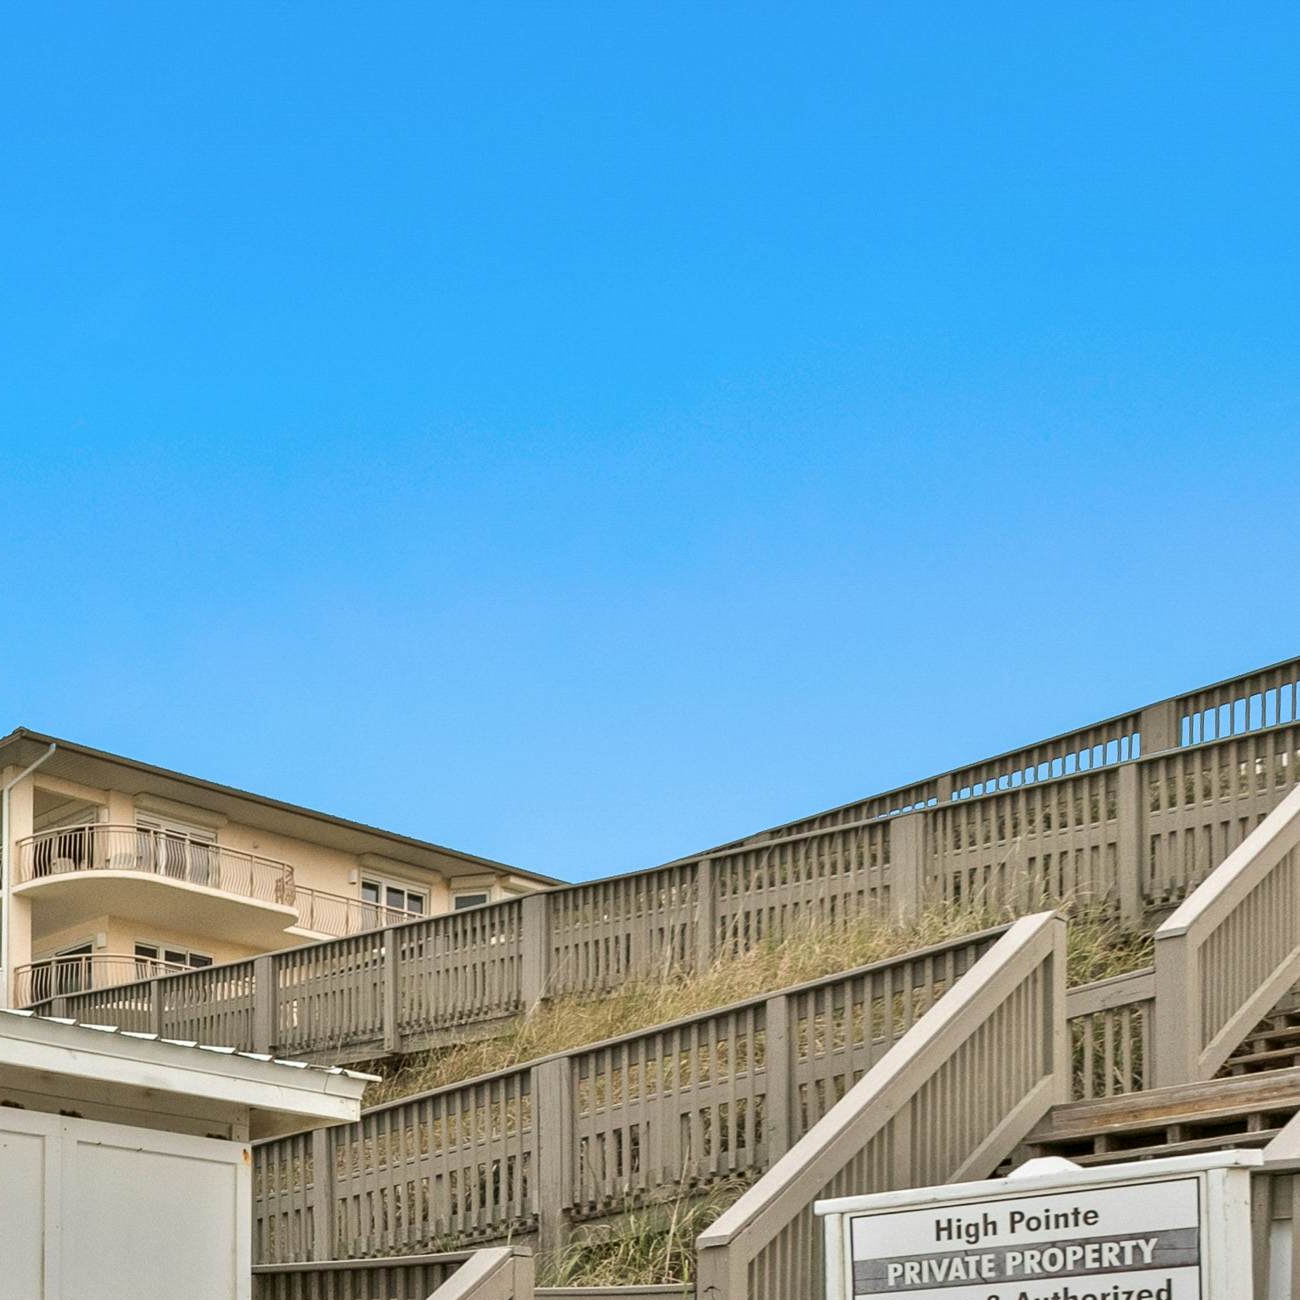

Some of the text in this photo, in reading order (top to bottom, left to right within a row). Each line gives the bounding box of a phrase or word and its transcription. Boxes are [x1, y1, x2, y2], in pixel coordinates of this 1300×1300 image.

[934, 1207, 1099, 1245] High Pointe
[887, 1237, 1158, 1286] PRIVATE PROPERTY
